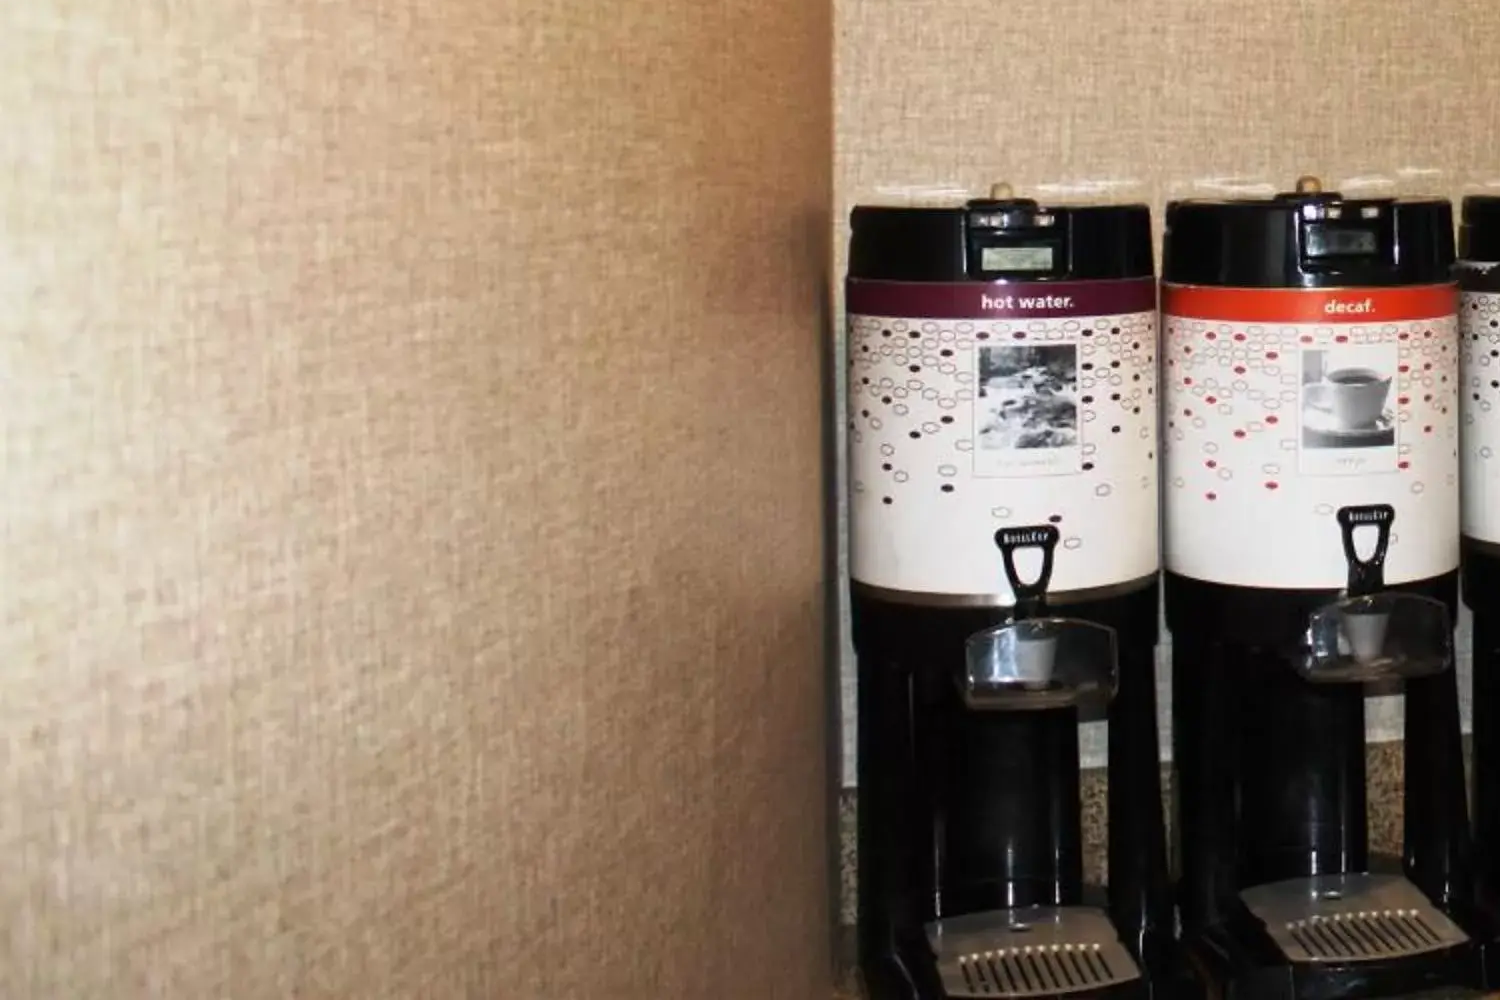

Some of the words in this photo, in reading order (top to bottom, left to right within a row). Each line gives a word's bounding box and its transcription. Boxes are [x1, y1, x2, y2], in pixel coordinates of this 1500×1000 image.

[981, 293, 1014, 310] hot
[1019, 294, 1075, 310] water.
[1324, 297, 1376, 313] decaf.
